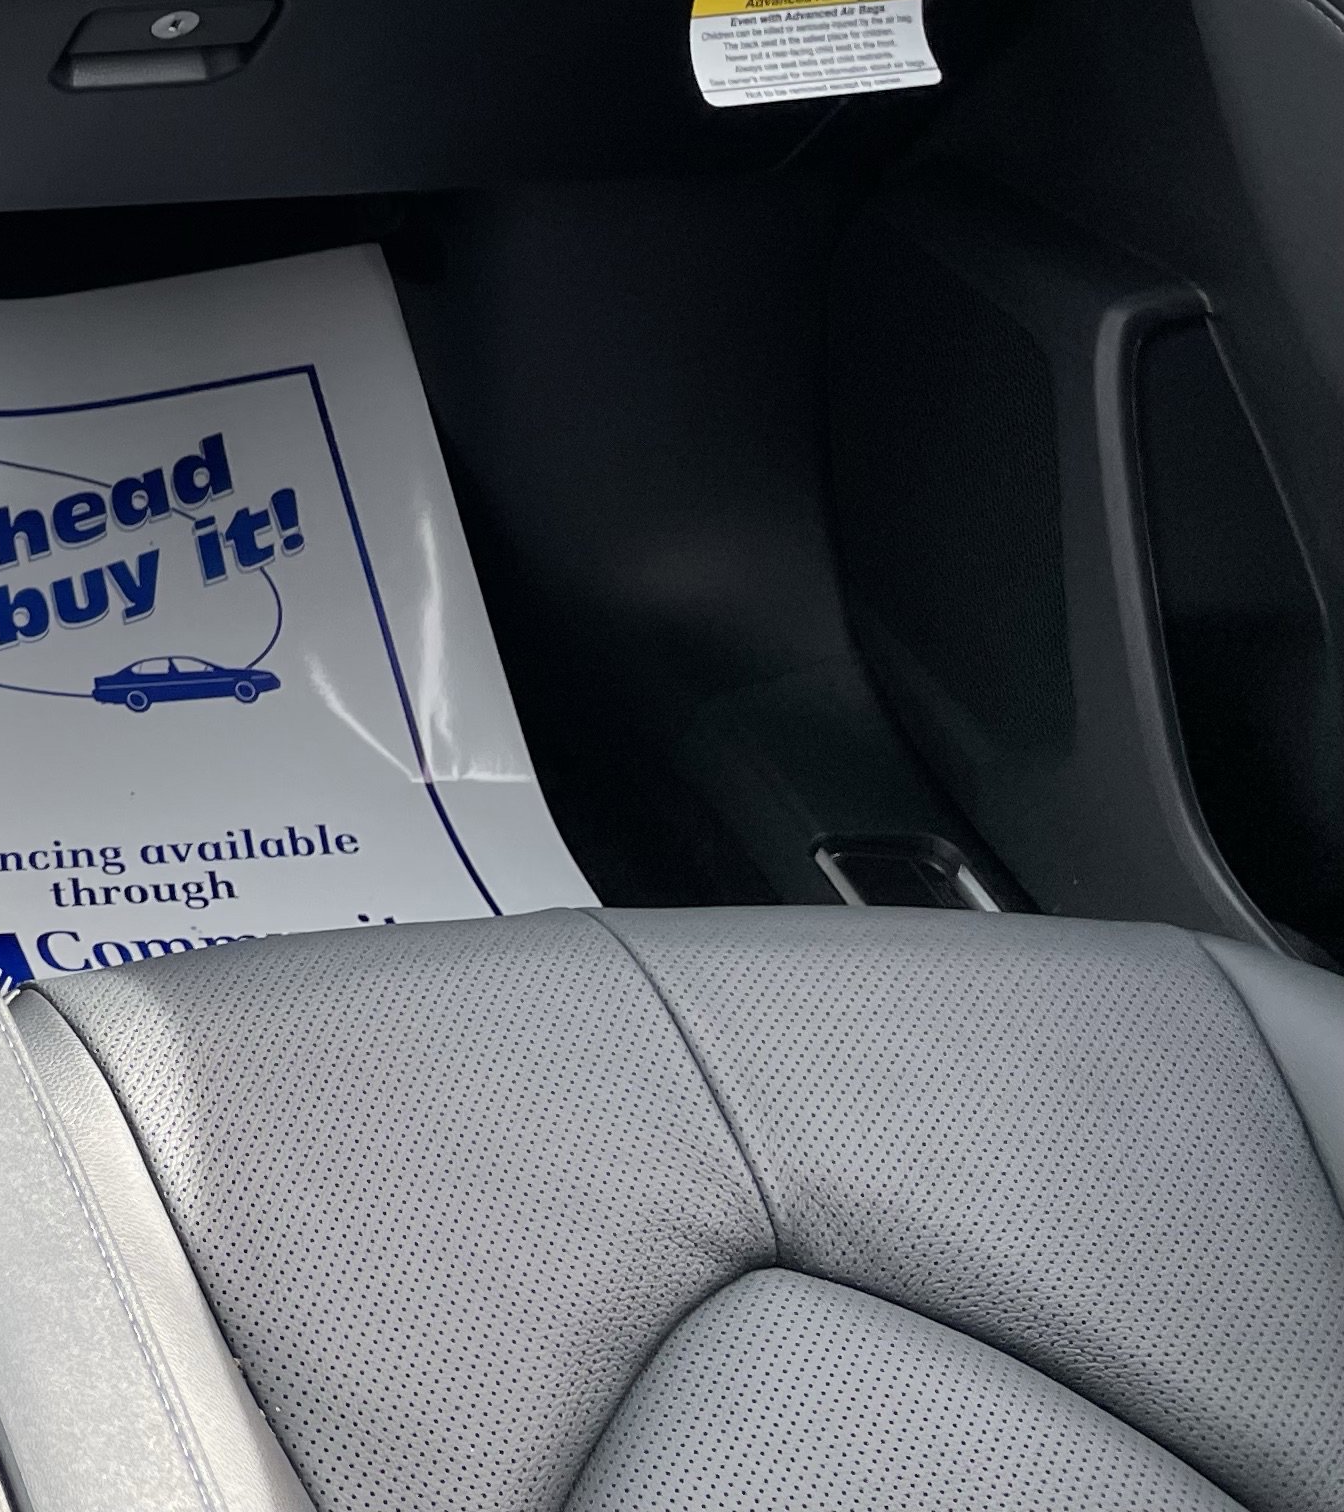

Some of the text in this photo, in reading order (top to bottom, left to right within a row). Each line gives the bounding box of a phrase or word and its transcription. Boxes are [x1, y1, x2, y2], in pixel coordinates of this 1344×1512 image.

[730, 4, 885, 27] Even with Advanced Air Bags
[193, 486, 306, 587] it!
[139, 823, 360, 867] available
[49, 870, 238, 911] through
